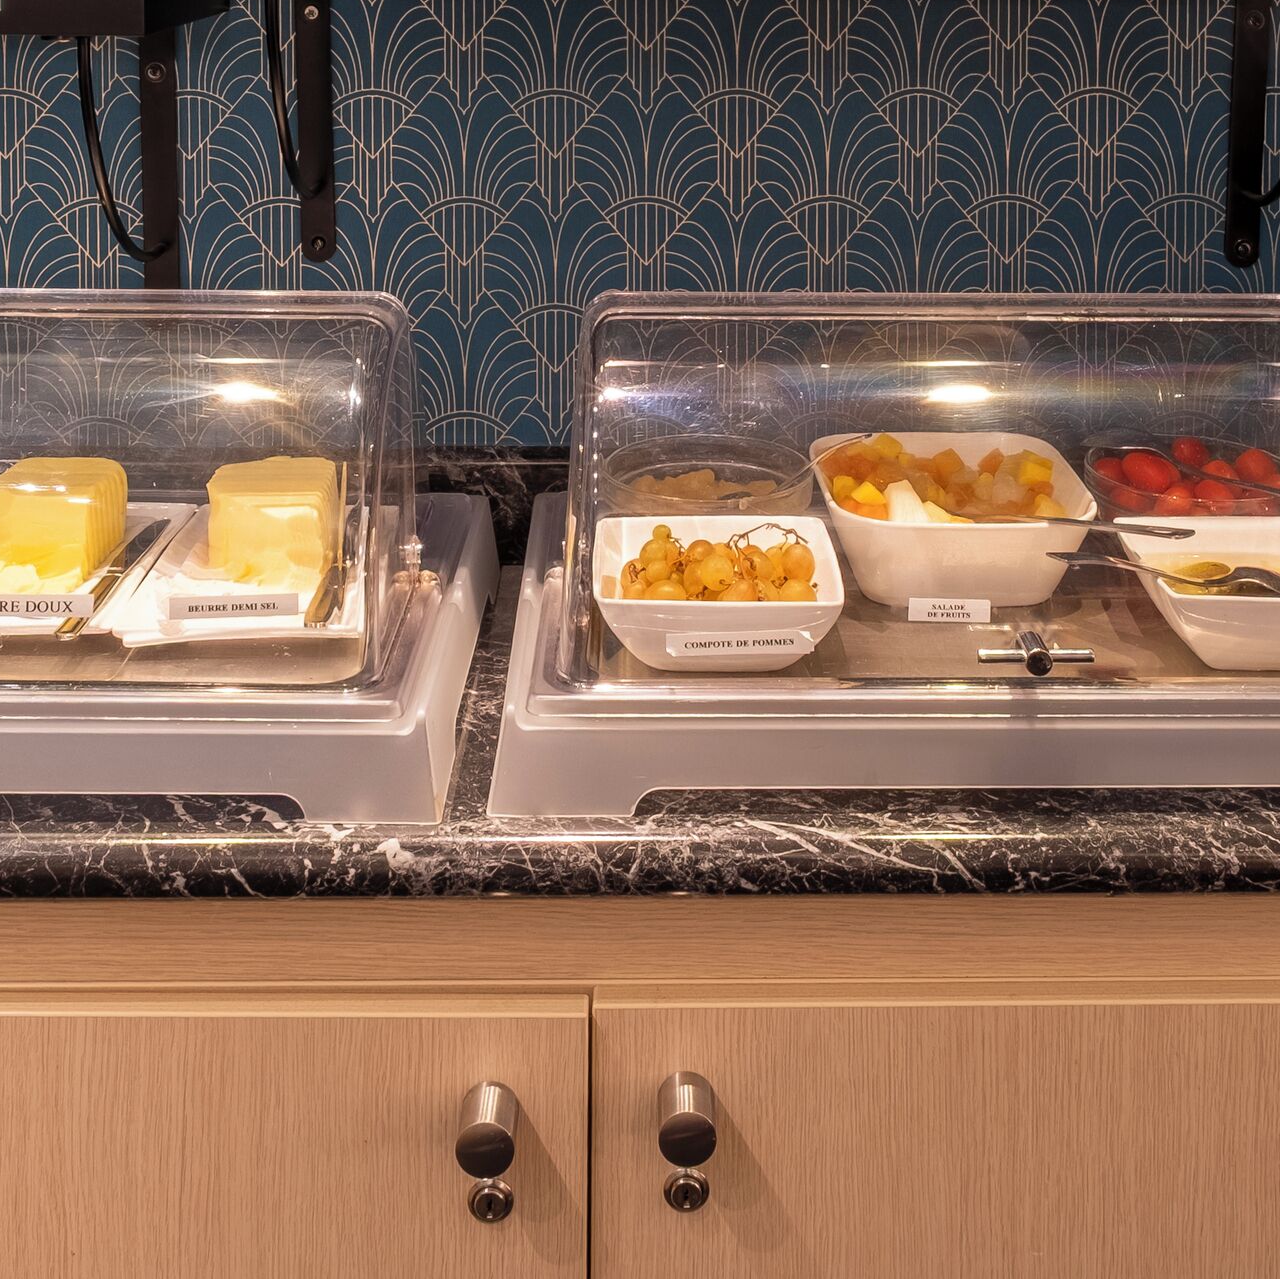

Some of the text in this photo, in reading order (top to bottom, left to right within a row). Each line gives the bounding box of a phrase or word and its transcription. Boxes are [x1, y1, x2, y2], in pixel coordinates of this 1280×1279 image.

[25, 600, 74, 613] DOUX
[187, 602, 279, 613] BEURRE DEMI SEL
[684, 638, 795, 649] COMPOTE DE POMMES
